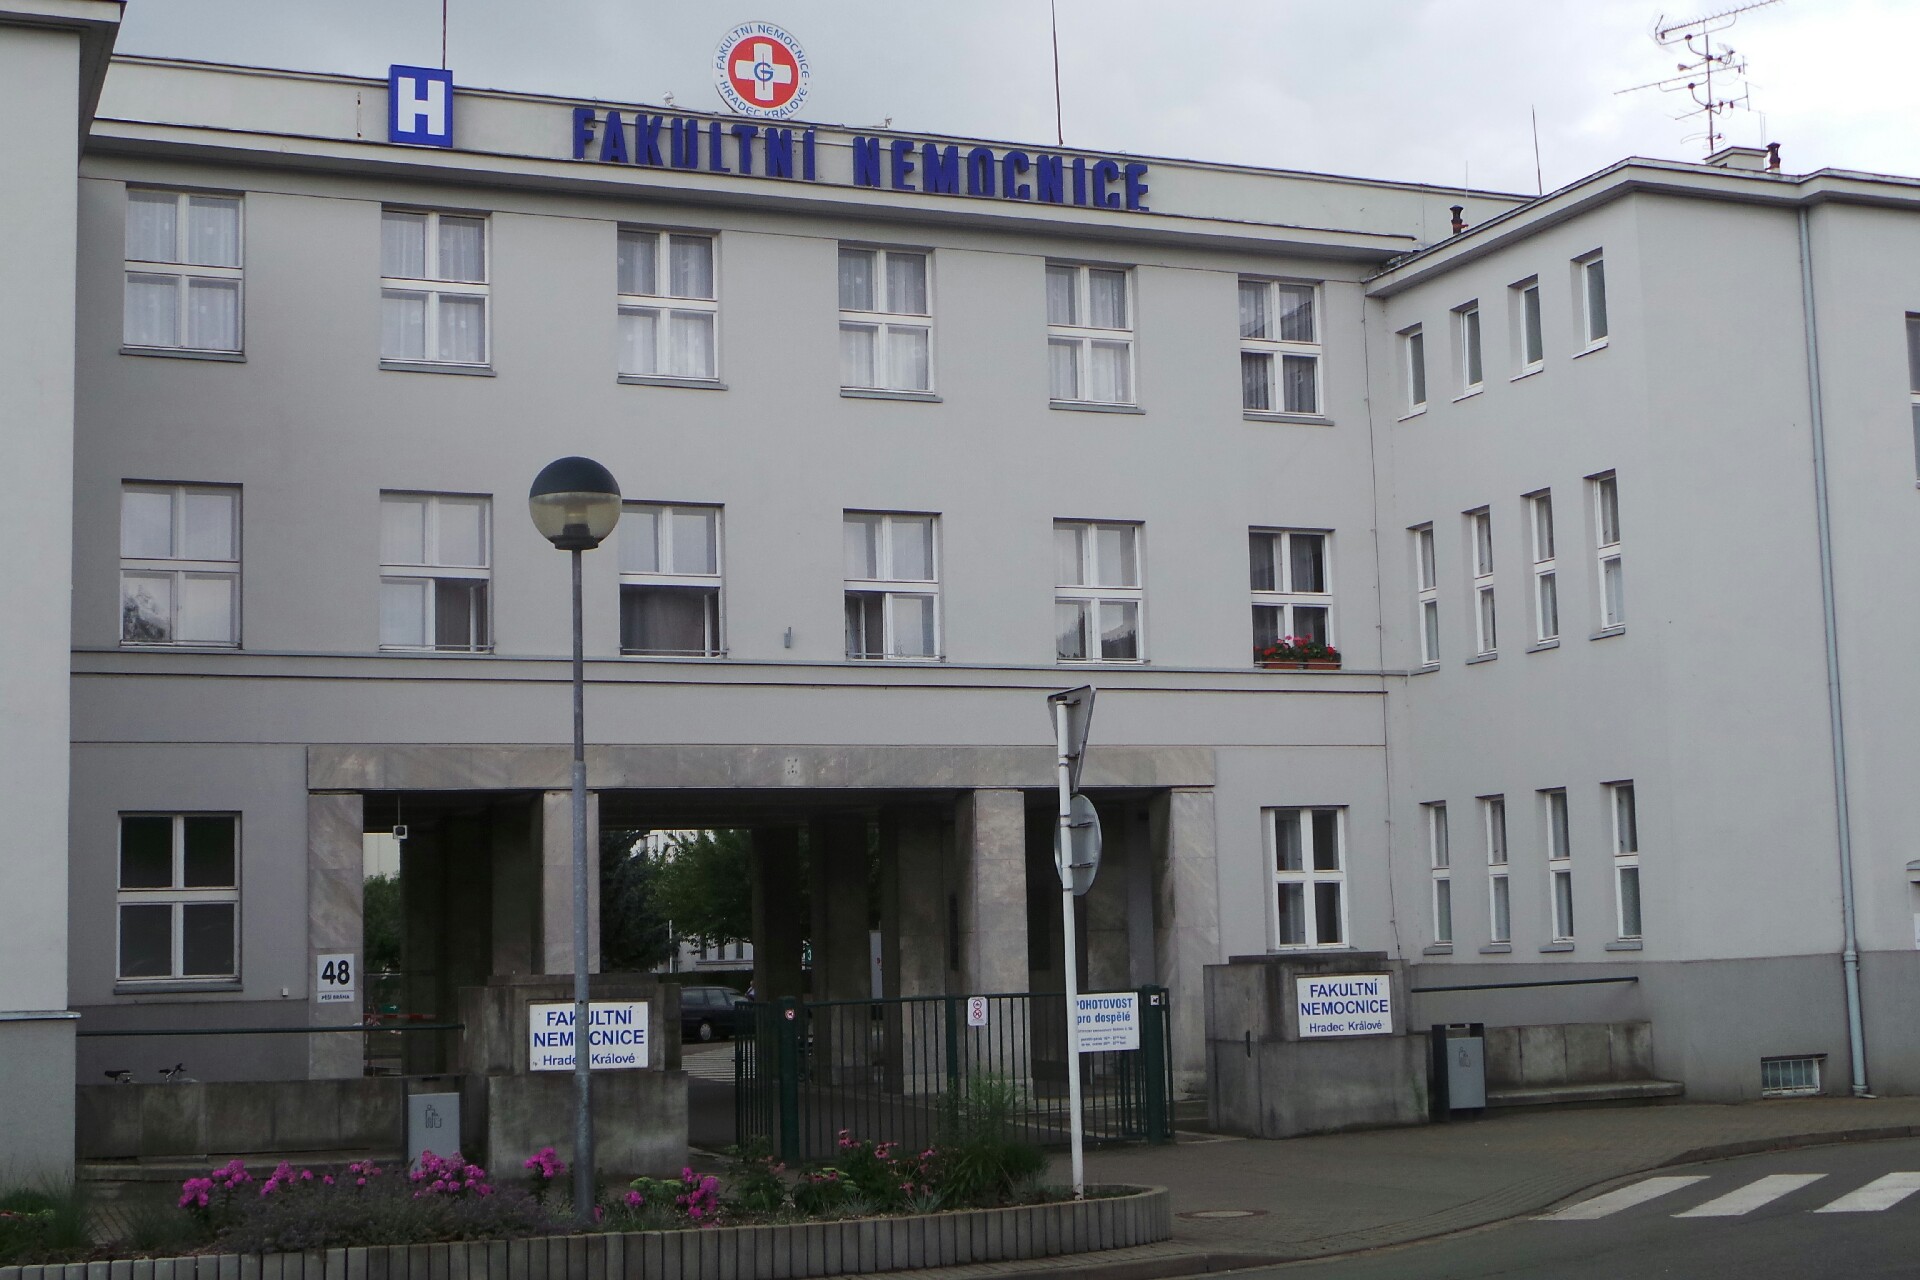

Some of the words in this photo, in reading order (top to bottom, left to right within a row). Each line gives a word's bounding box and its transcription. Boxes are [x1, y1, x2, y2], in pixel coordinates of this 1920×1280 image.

[716, 25, 753, 71] FAKULTNÍ
[758, 24, 810, 79] NEMOCNICE
[397, 76, 446, 136] H
[720, 81, 760, 116] HRADEC
[572, 107, 817, 181] FAKULTNÍ
[852, 136, 1150, 212] NEMOCNICE
[321, 960, 350, 985] 48
[1310, 978, 1378, 998] FAKULTNÍ
[1301, 999, 1389, 1016] NEMOCNICE
[1077, 1015, 1091, 1026] pro
[1095, 1011, 1131, 1024] dospělé
[1310, 1022, 1344, 1033] Hradec
[1348, 1020, 1382, 1031] Králové
[533, 1029, 645, 1047] NEMCNICE
[543, 1055, 576, 1066] Hrade
[591, 1053, 636, 1065] Králové
